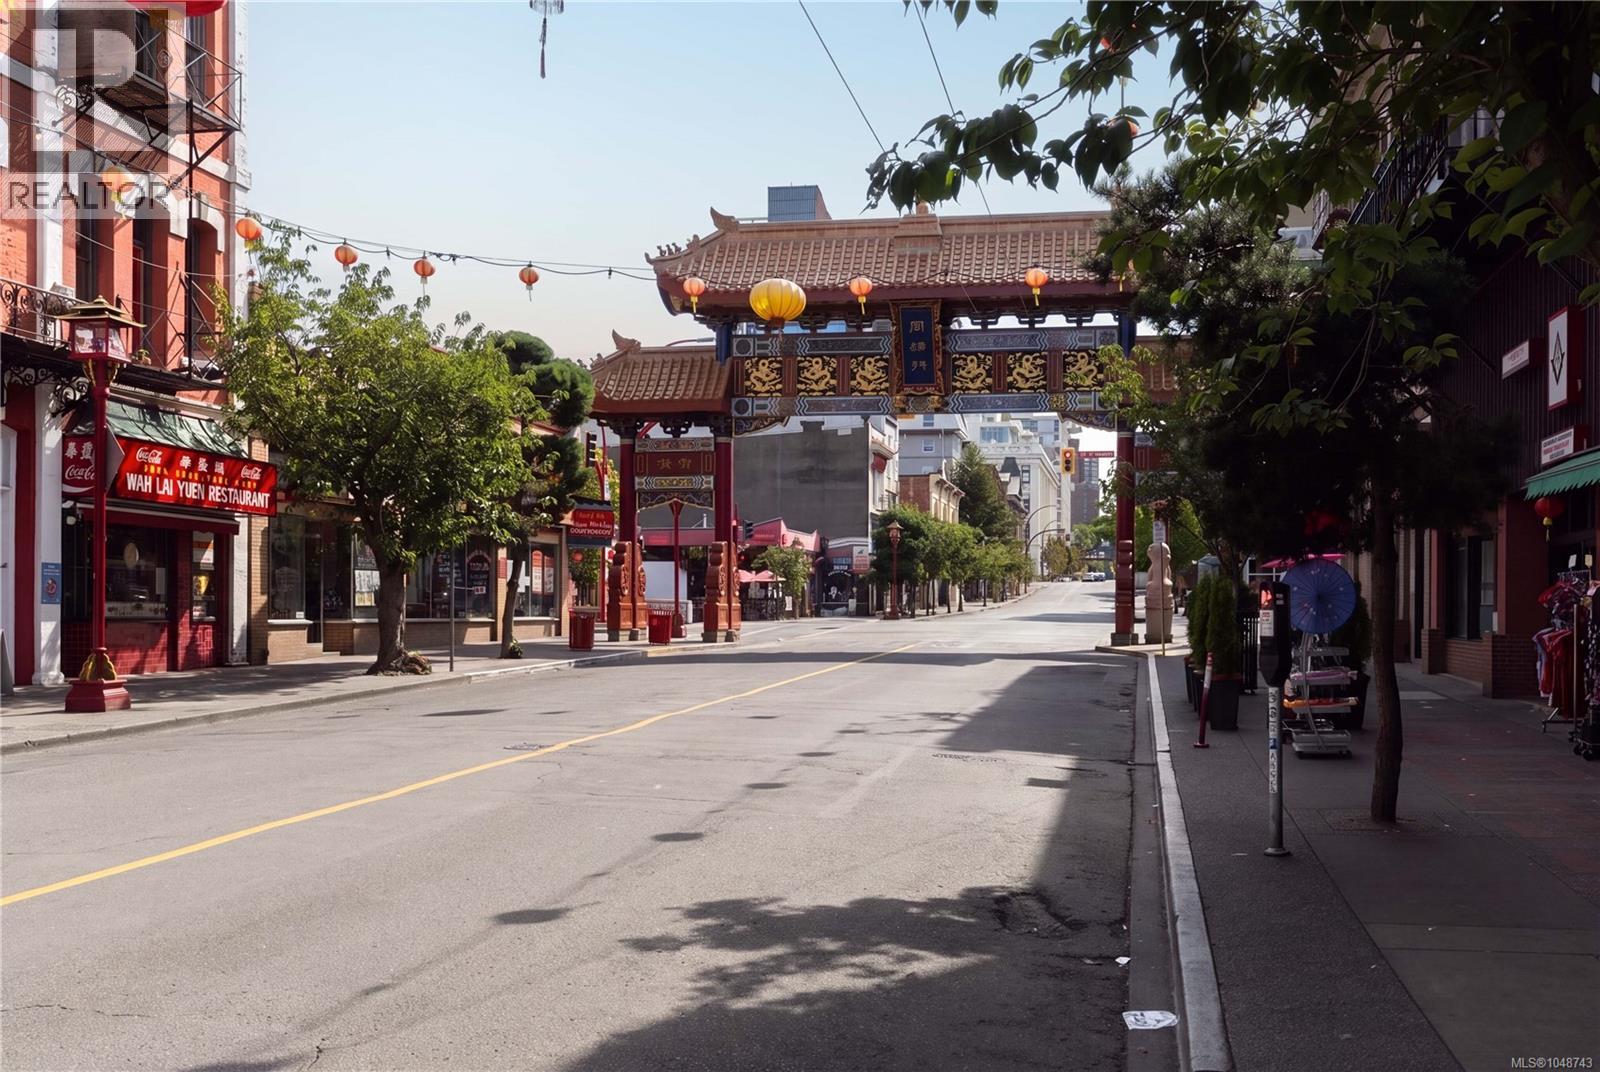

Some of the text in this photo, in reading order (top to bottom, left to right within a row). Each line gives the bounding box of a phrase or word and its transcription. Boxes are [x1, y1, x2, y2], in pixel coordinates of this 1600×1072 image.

[126, 472, 152, 493] WAH
[156, 476, 173, 496] LAI
[177, 480, 205, 500] YUEN
[208, 485, 270, 509] RESTAURANT
